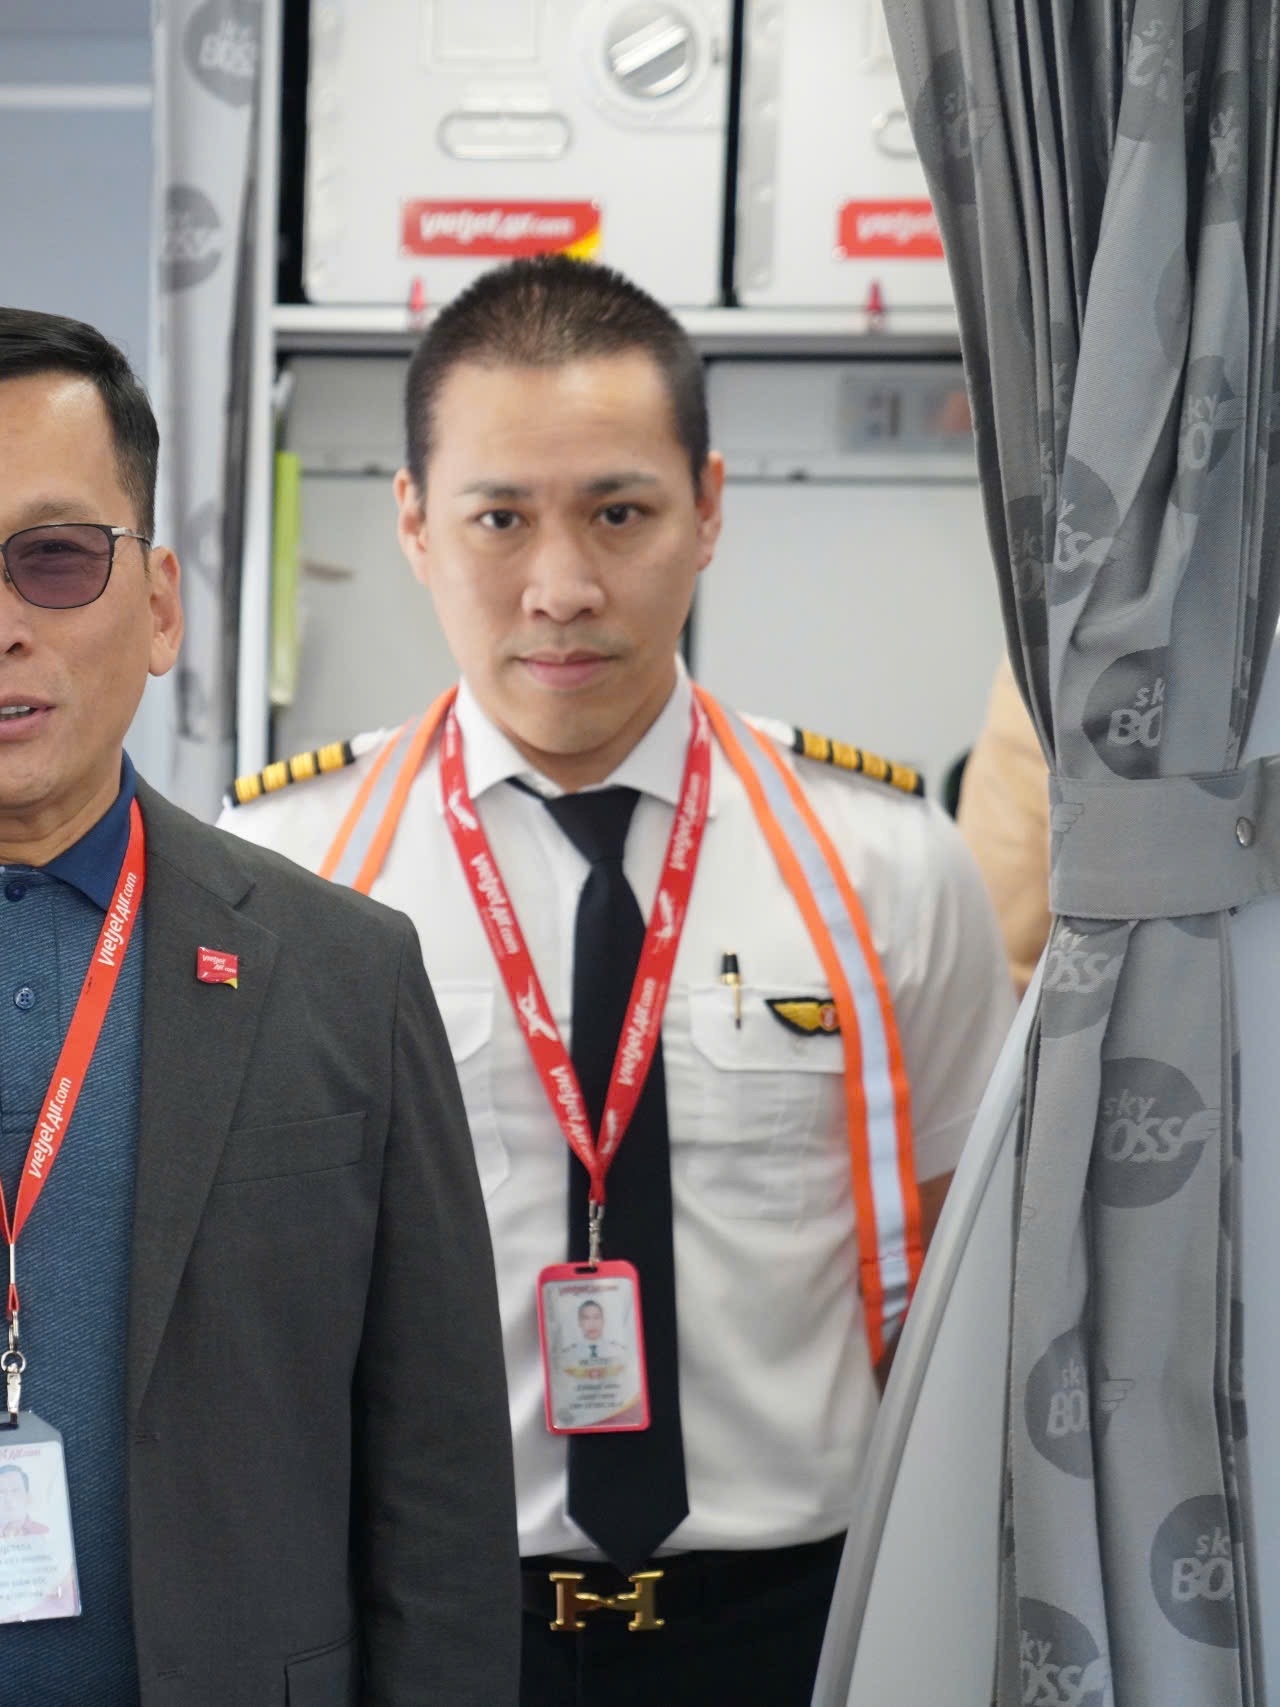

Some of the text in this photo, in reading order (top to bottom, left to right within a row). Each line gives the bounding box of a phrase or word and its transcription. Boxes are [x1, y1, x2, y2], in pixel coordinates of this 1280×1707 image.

[1134, 678, 1166, 707] sk
[1102, 1116, 1186, 1162] OSS
[1195, 1526, 1231, 1556] sk
